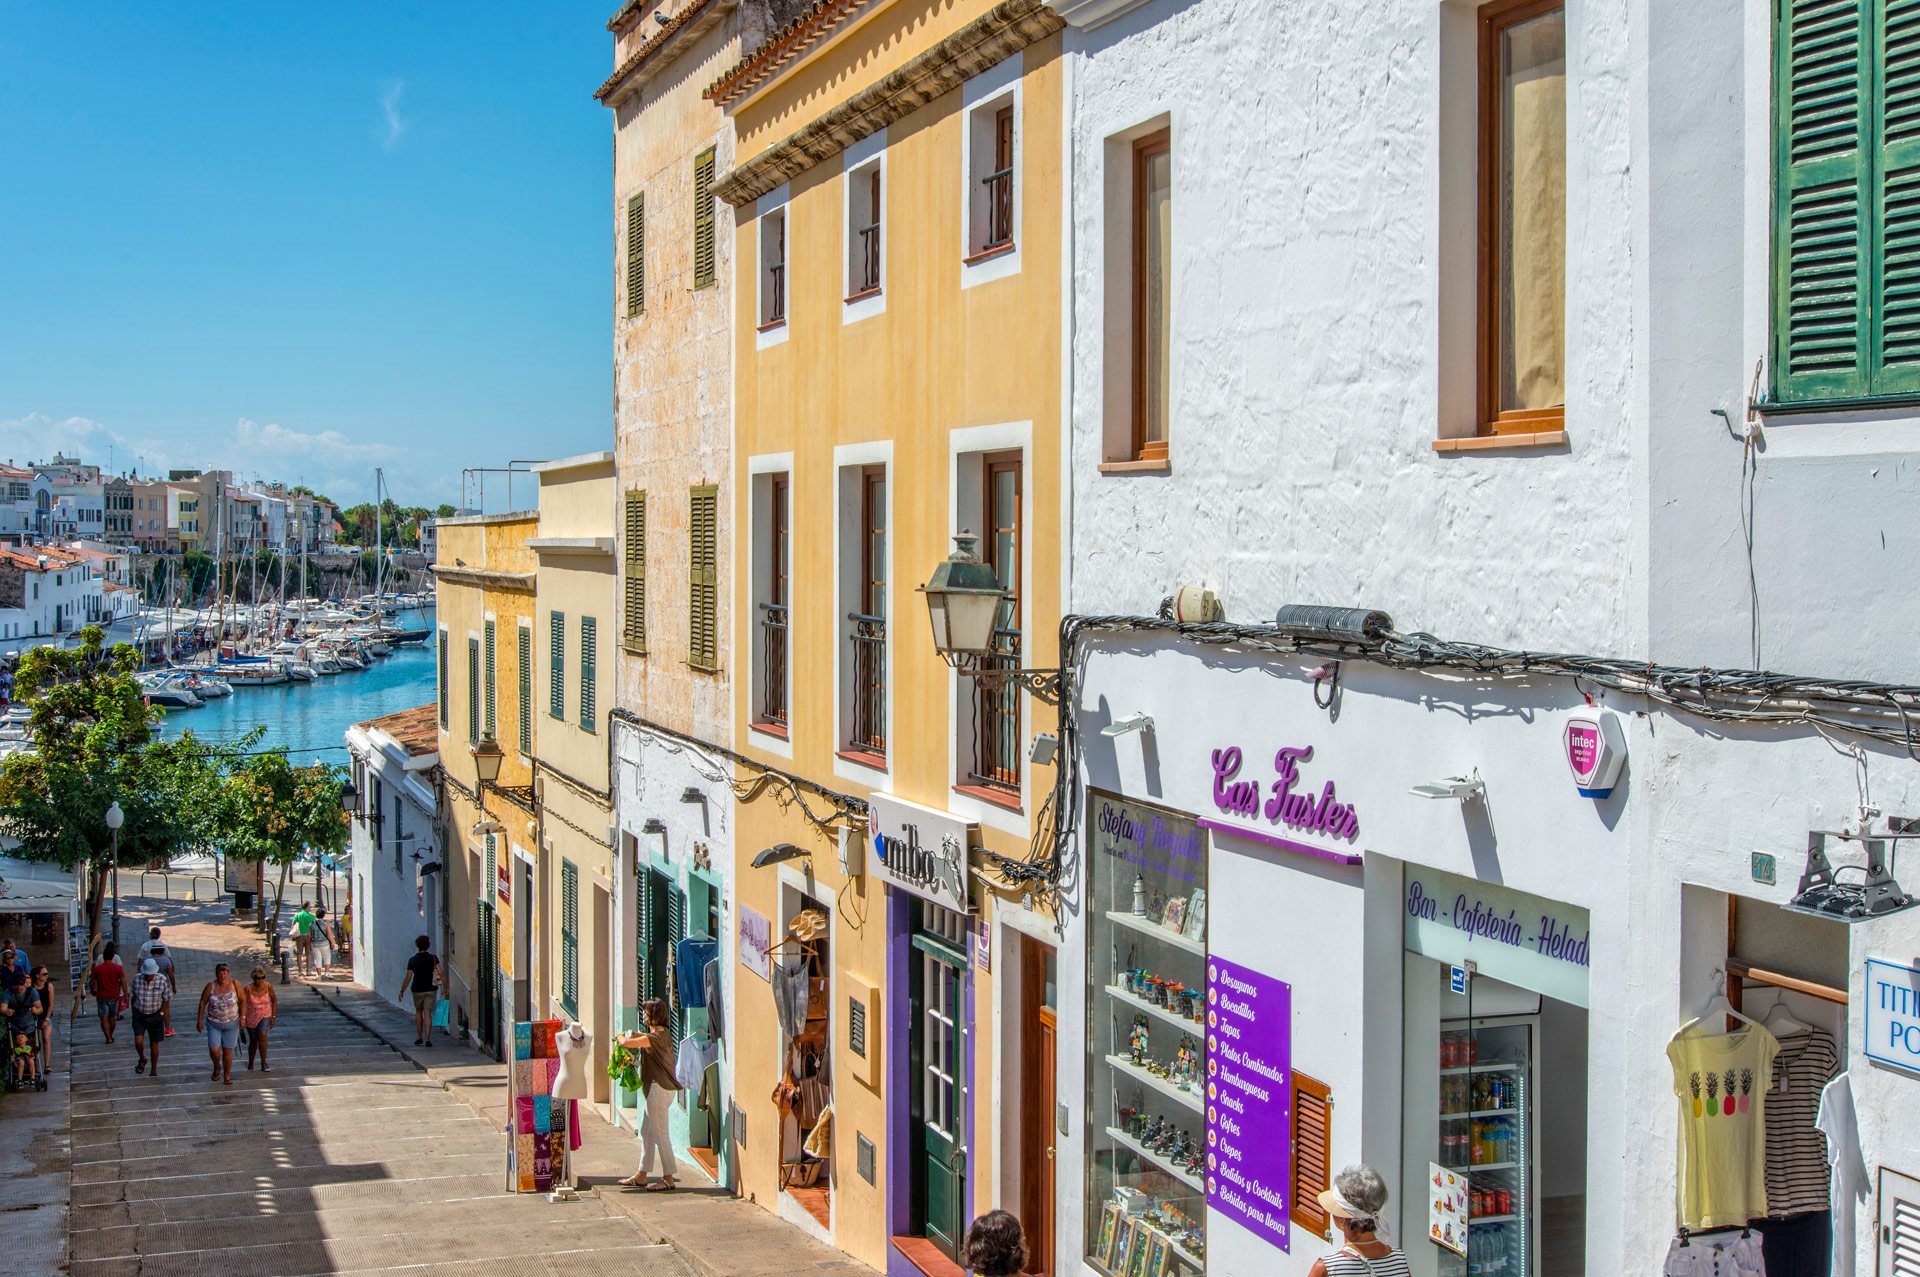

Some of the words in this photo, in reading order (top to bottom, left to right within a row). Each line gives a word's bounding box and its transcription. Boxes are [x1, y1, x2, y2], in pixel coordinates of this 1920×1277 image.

[1572, 734, 1595, 749] intec
[1212, 746, 1259, 815] Cas
[1265, 745, 1358, 838] Fuster
[1098, 802, 1148, 850] Stefany
[1151, 815, 1200, 863] Regals
[1408, 881, 1437, 922] Bar
[1453, 894, 1522, 947] Cafetería
[1538, 915, 1590, 968] Helad
[1221, 969, 1257, 998] Desayunos
[1877, 981, 1920, 1018] TITI
[1221, 993, 1255, 1022] Bocadillos
[1221, 1017, 1241, 1040] Tapas
[1221, 1041, 1241, 1065] Platos
[1242, 1052, 1284, 1085] Combinados
[1220, 1089, 1244, 1115] Snacks
[1221, 1065, 1270, 1102] Hamburguesas
[1220, 1113, 1241, 1137] Gofres
[1220, 1137, 1242, 1162] Crepes
[1220, 1160, 1246, 1188] Batidos
[1245, 1180, 1252, 1194] y
[1252, 1179, 1284, 1210] Cocktails
[1220, 1184, 1247, 1213] Bebidas
[1246, 1205, 1265, 1224] para
[1265, 1212, 1286, 1236] llevar
